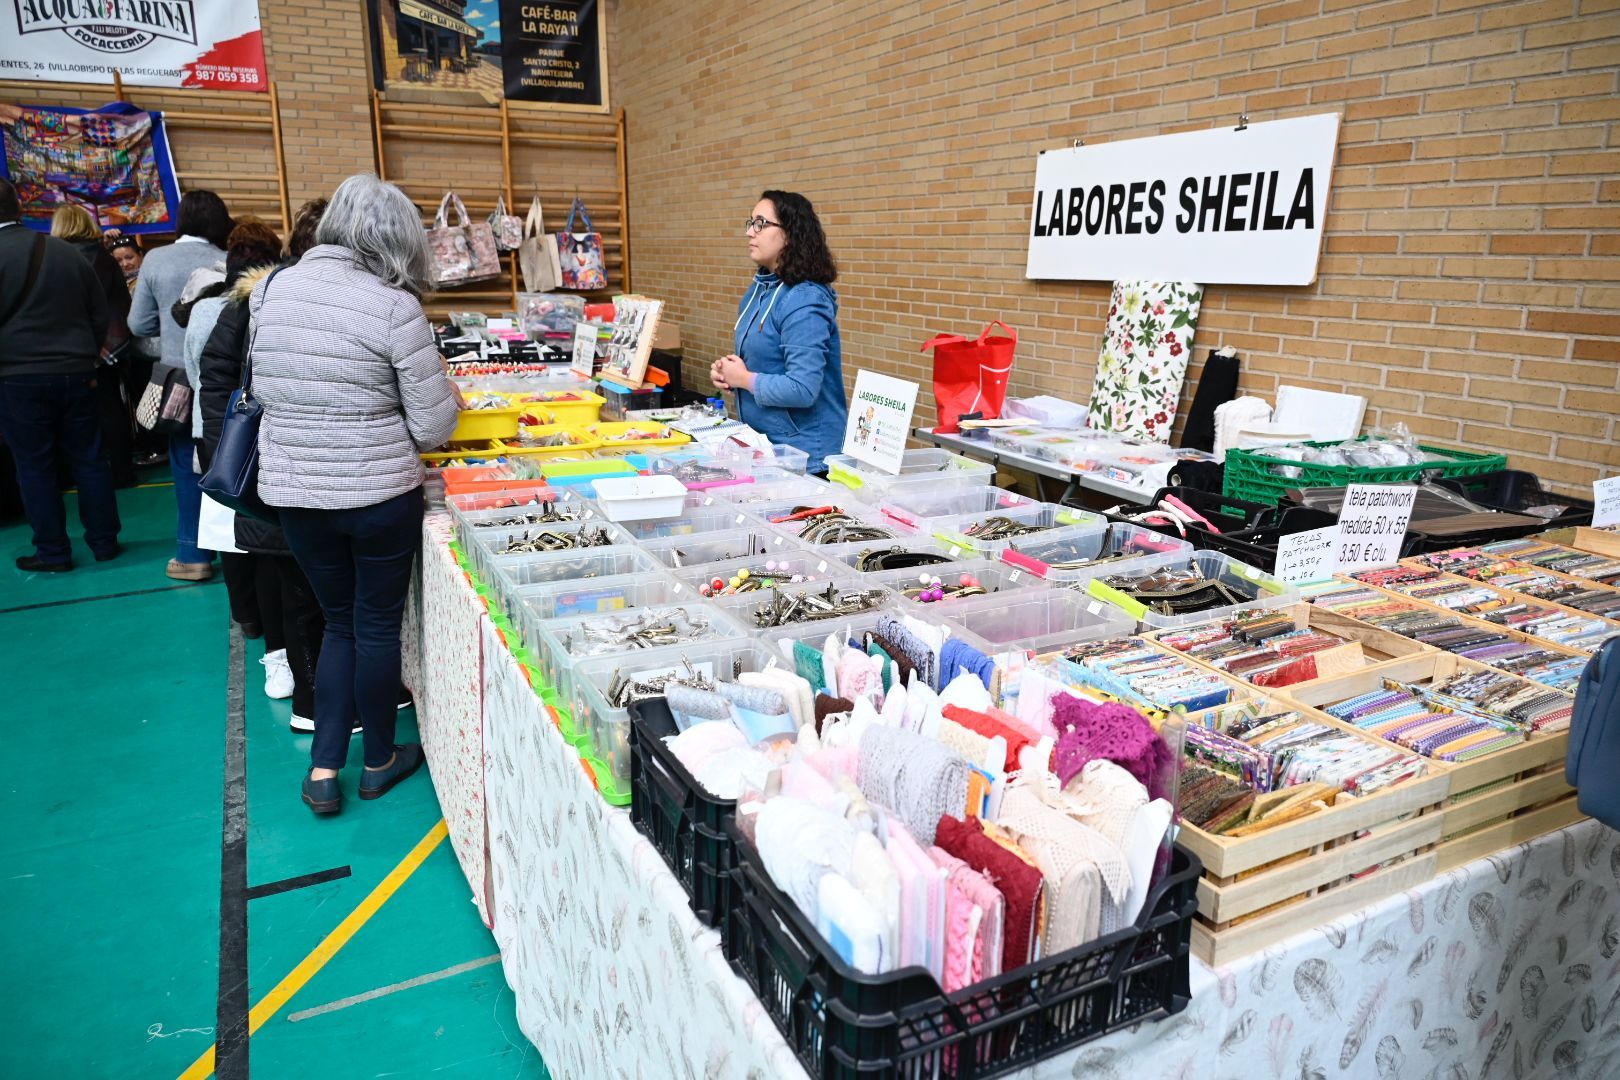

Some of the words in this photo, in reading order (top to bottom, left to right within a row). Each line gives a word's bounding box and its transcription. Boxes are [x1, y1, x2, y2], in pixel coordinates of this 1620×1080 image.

[113, 0, 191, 35] FARINA
[522, 21, 537, 33] LA
[539, 22, 569, 36] RAYA
[571, 25, 579, 36] II
[74, 28, 147, 50] FOCACCERIA
[538, 48, 565, 58] PARAJE
[0, 60, 31, 70] ENTES,
[34, 62, 45, 70] 26
[48, 61, 105, 73] (VILLAOBISPO
[120, 67, 135, 75] LAS
[136, 68, 182, 78] REGUERAS)
[523, 58, 548, 67] SANTO
[575, 61, 580, 69] 2
[196, 70, 215, 81] 987
[217, 72, 238, 82] 059
[239, 73, 259, 84] 358
[531, 68, 573, 79] NAVATEJERA
[521, 77, 584, 90] (VILLAQUILAMBRE)
[1033, 179, 1166, 237] LABORES
[1175, 167, 1314, 234] SHEILA
[859, 390, 884, 405] LABORES
[884, 397, 906, 412] SHEILA
[1349, 487, 1367, 506] tela
[1366, 487, 1413, 511] patchwork
[1341, 516, 1372, 535] medida
[1373, 516, 1387, 535] 50
[1386, 520, 1394, 535] x
[1394, 516, 1408, 535] 55
[1291, 533, 1322, 546] TELAS
[1282, 541, 1331, 558] PATCHWORK
[1339, 543, 1361, 565] 3,50
[1364, 543, 1373, 562] €
